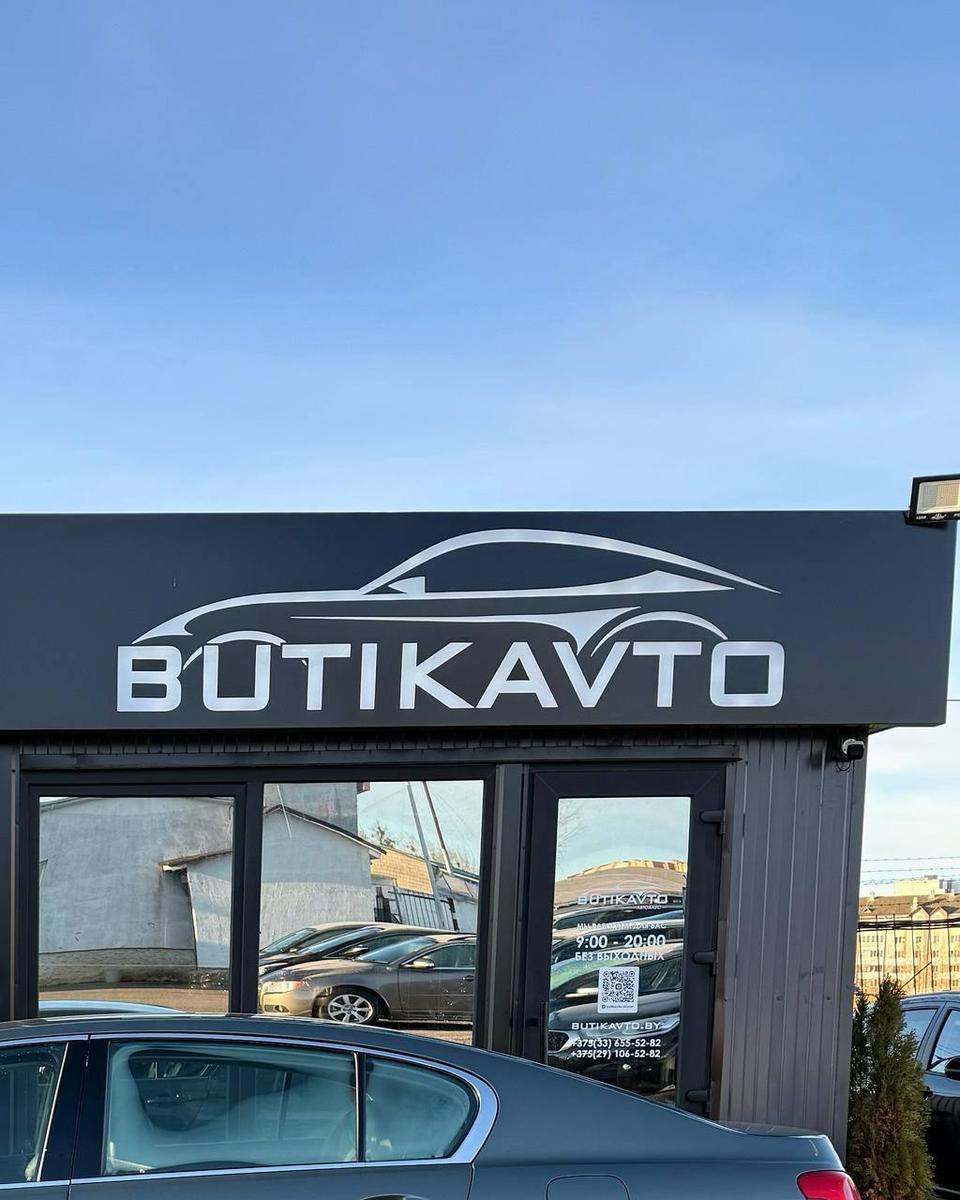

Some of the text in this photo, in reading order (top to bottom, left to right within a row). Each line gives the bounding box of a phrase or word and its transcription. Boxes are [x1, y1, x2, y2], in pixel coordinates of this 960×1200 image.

[116, 640, 785, 712] BUTIKAVTO
[578, 894, 668, 904] BUTIKAVTO
[576, 935, 608, 948] 9:00
[624, 934, 666, 948] 20:00
[575, 951, 665, 962] БЕЗ ВЫХОДНЫХ
[571, 1022, 662, 1030] BUTIKAVTO.BY
[572, 1038, 661, 1048] +375(33) 655-52-82
[570, 1049, 661, 1059] +375(29) 106-52-82
